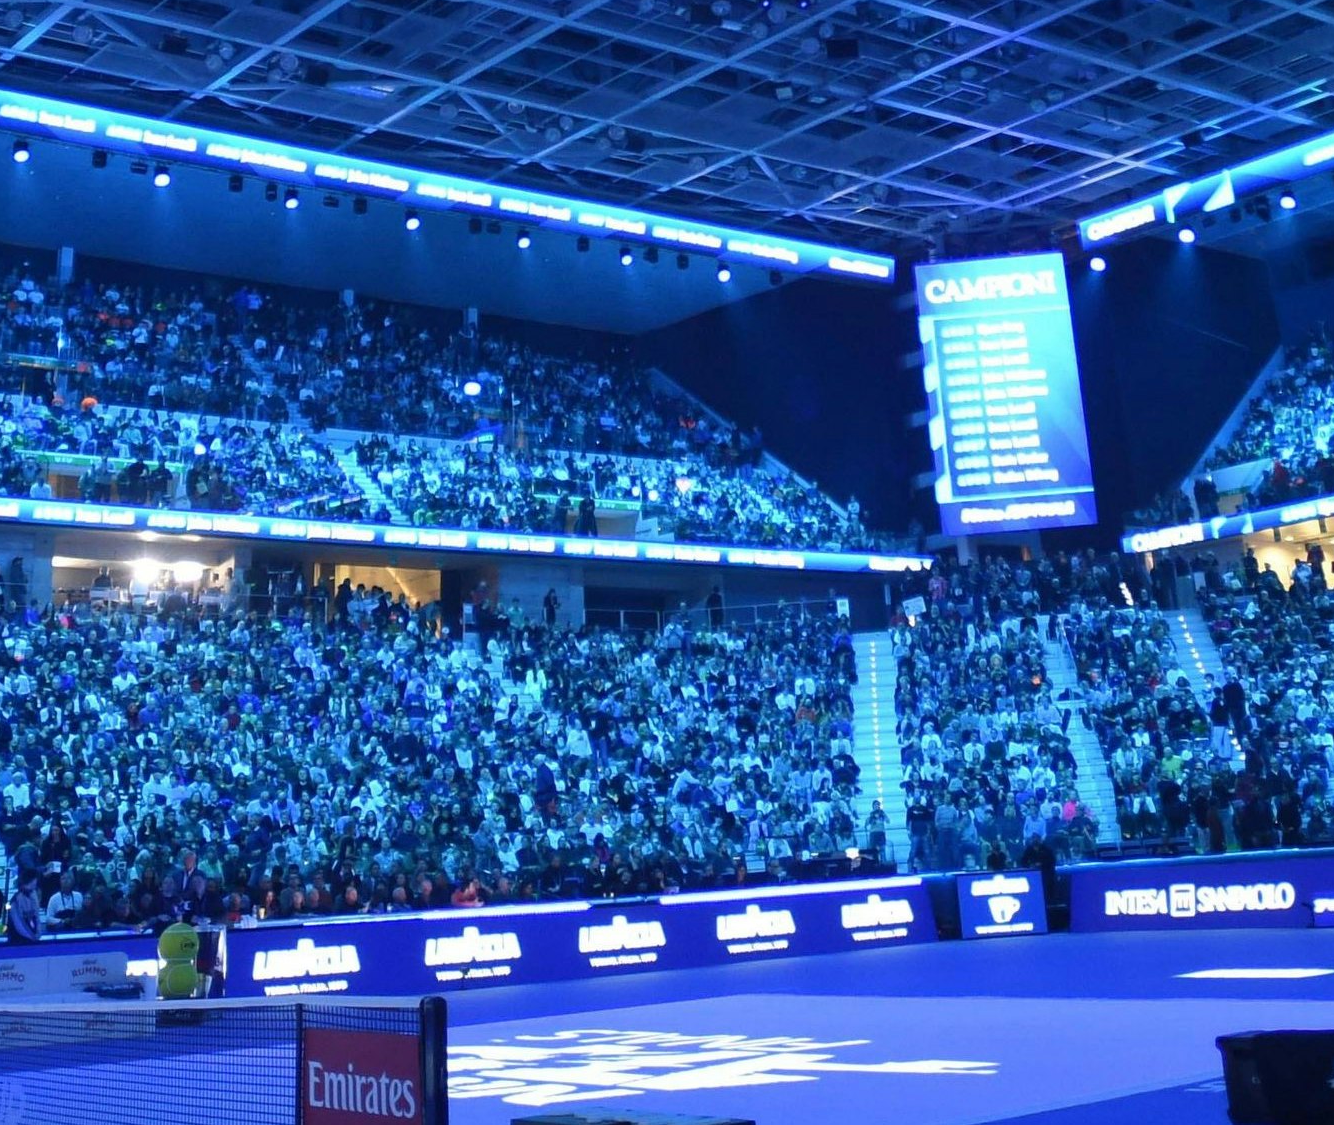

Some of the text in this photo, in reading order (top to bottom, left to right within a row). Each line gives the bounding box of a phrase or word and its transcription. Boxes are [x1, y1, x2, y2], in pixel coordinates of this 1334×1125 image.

[1104, 888, 1168, 916] INTESA
[71, 966, 108, 978] RUMMO
[308, 1061, 416, 1119] Emirates
